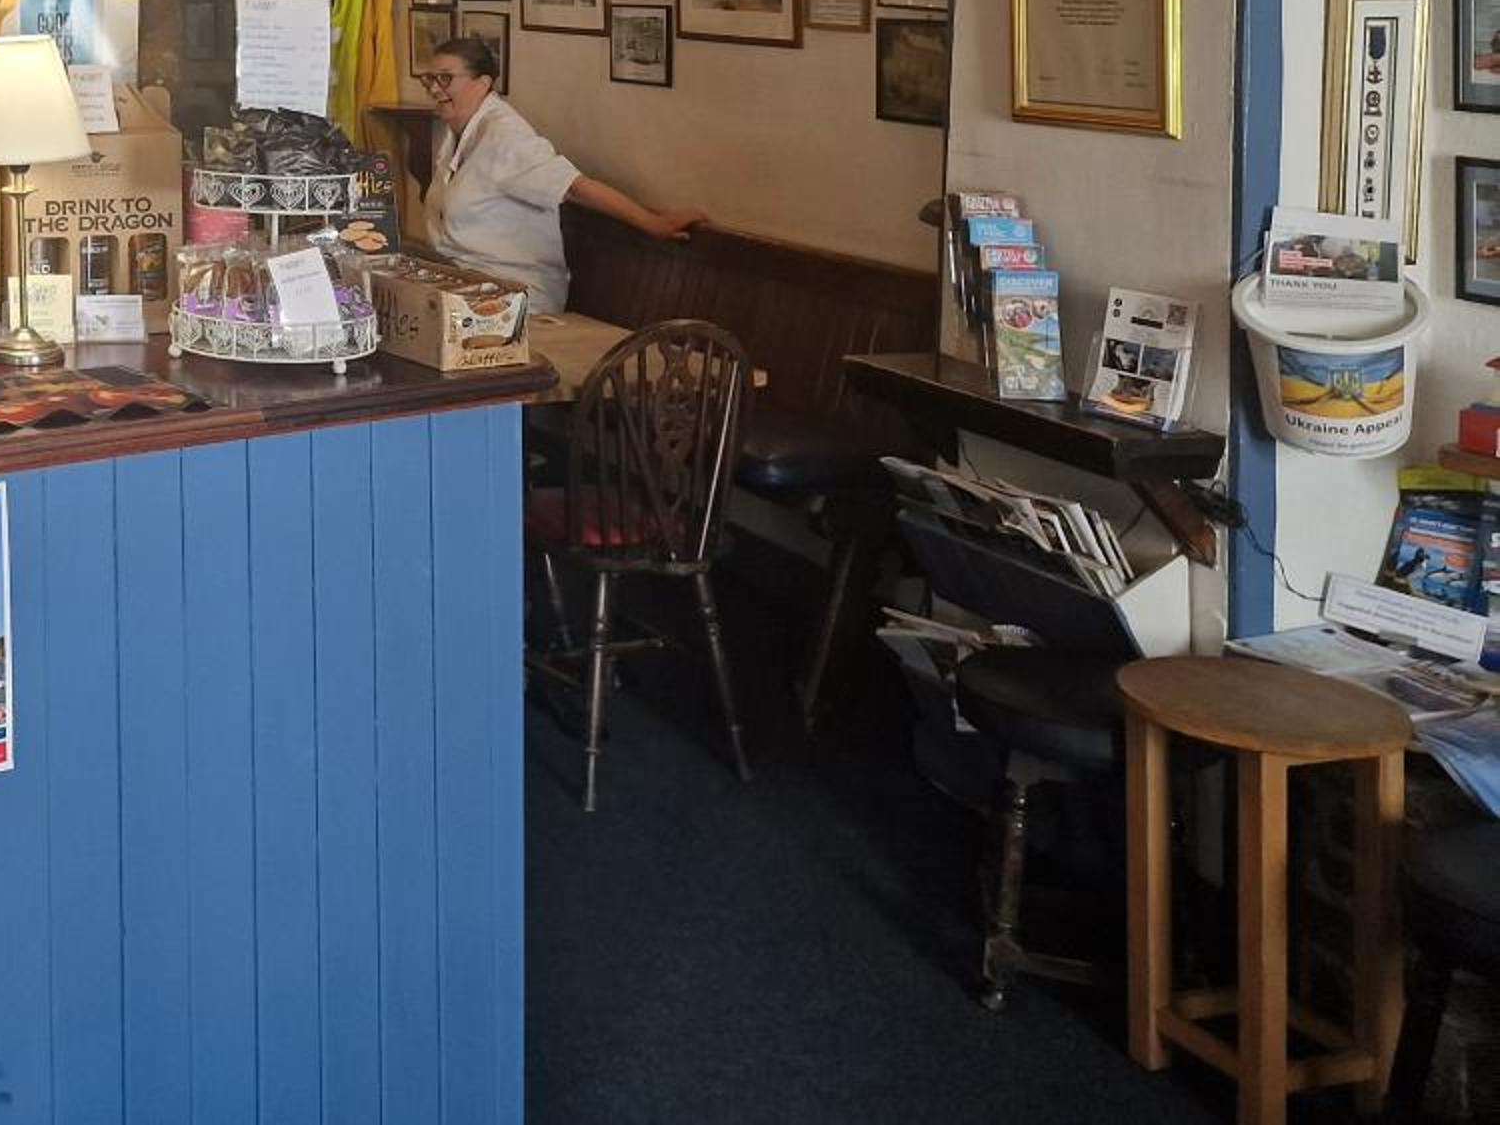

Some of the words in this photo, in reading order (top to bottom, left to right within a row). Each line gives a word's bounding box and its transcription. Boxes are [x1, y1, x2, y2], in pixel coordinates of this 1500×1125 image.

[44, 198, 115, 217] DRINK
[121, 196, 153, 213] TO
[23, 216, 68, 234] THE
[77, 212, 173, 234] DRAGON
[1268, 278, 1309, 290] THANK
[1312, 279, 1338, 291] YOU
[1283, 412, 1349, 436] Ukraine
[1353, 411, 1404, 436] Appeal
